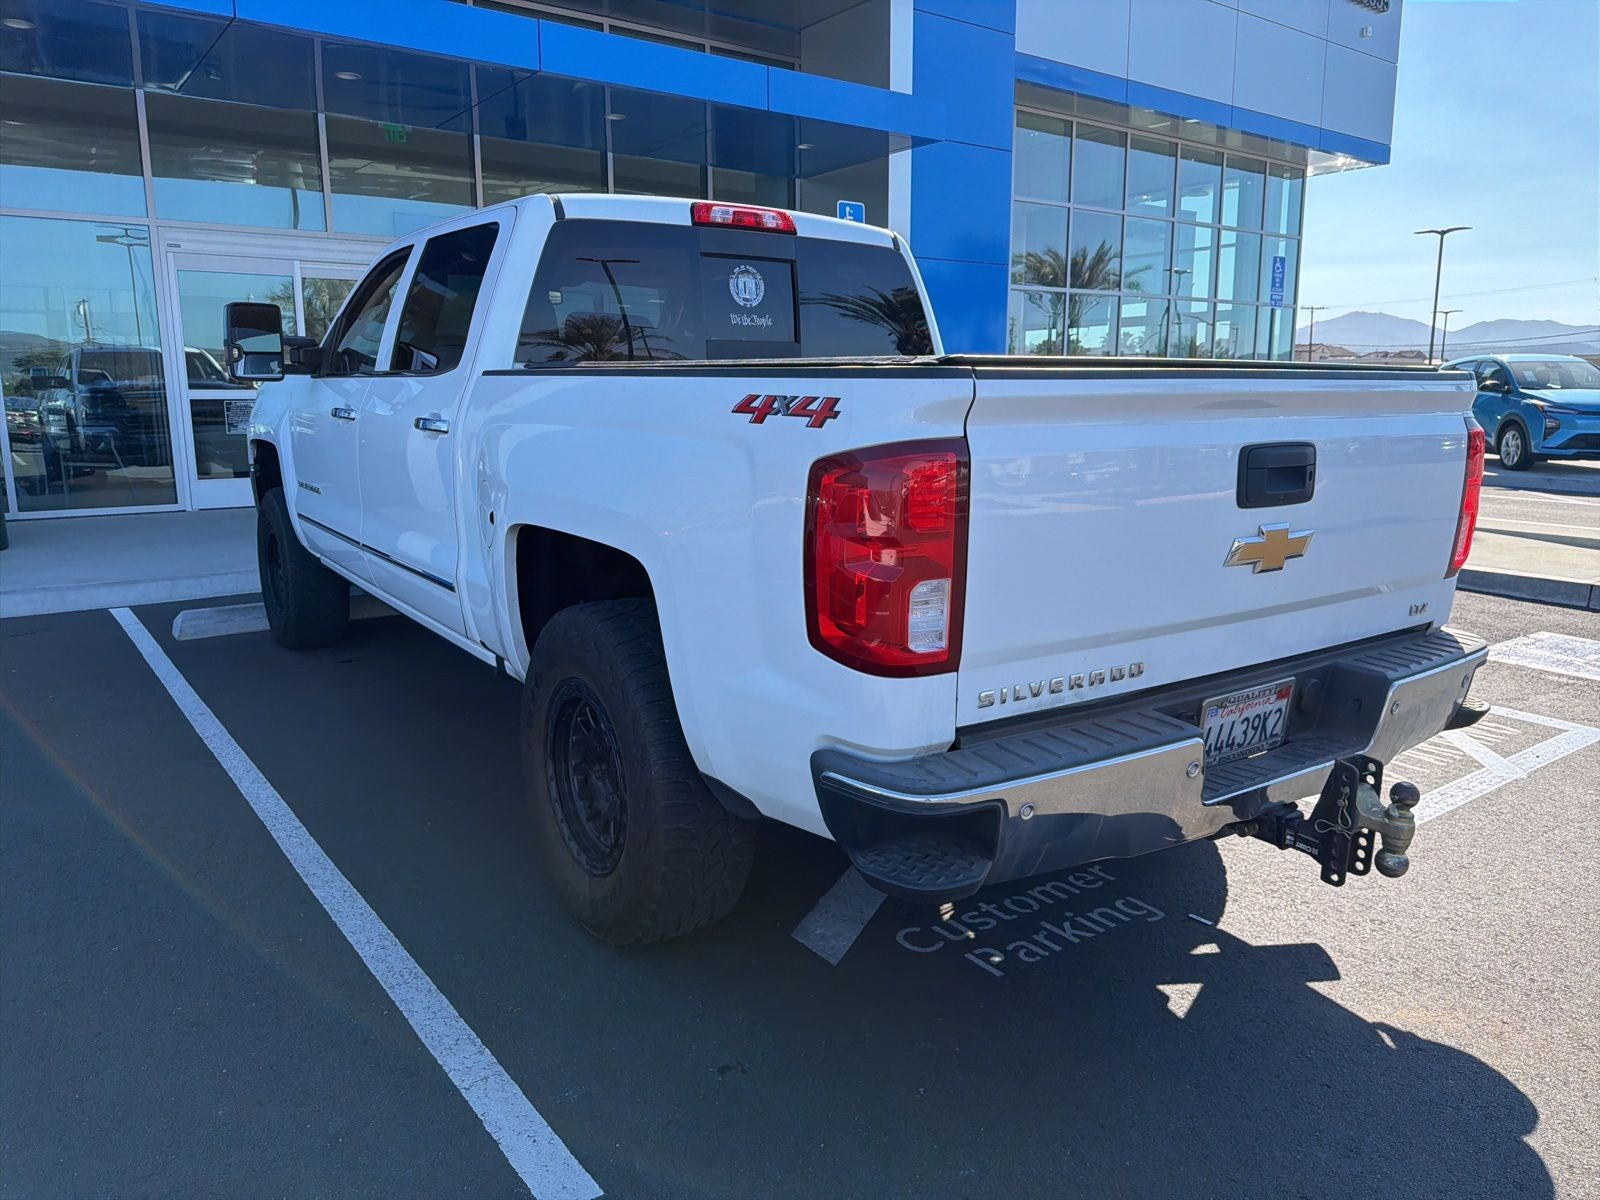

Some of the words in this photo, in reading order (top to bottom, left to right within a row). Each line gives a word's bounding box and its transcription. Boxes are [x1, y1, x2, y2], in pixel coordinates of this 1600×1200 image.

[978, 662, 1144, 708] SILVERADO
[1220, 696, 1276, 718] California
[1228, 687, 1276, 705] QUALITY
[896, 864, 1116, 953] Customer
[964, 896, 1165, 977] Parking
